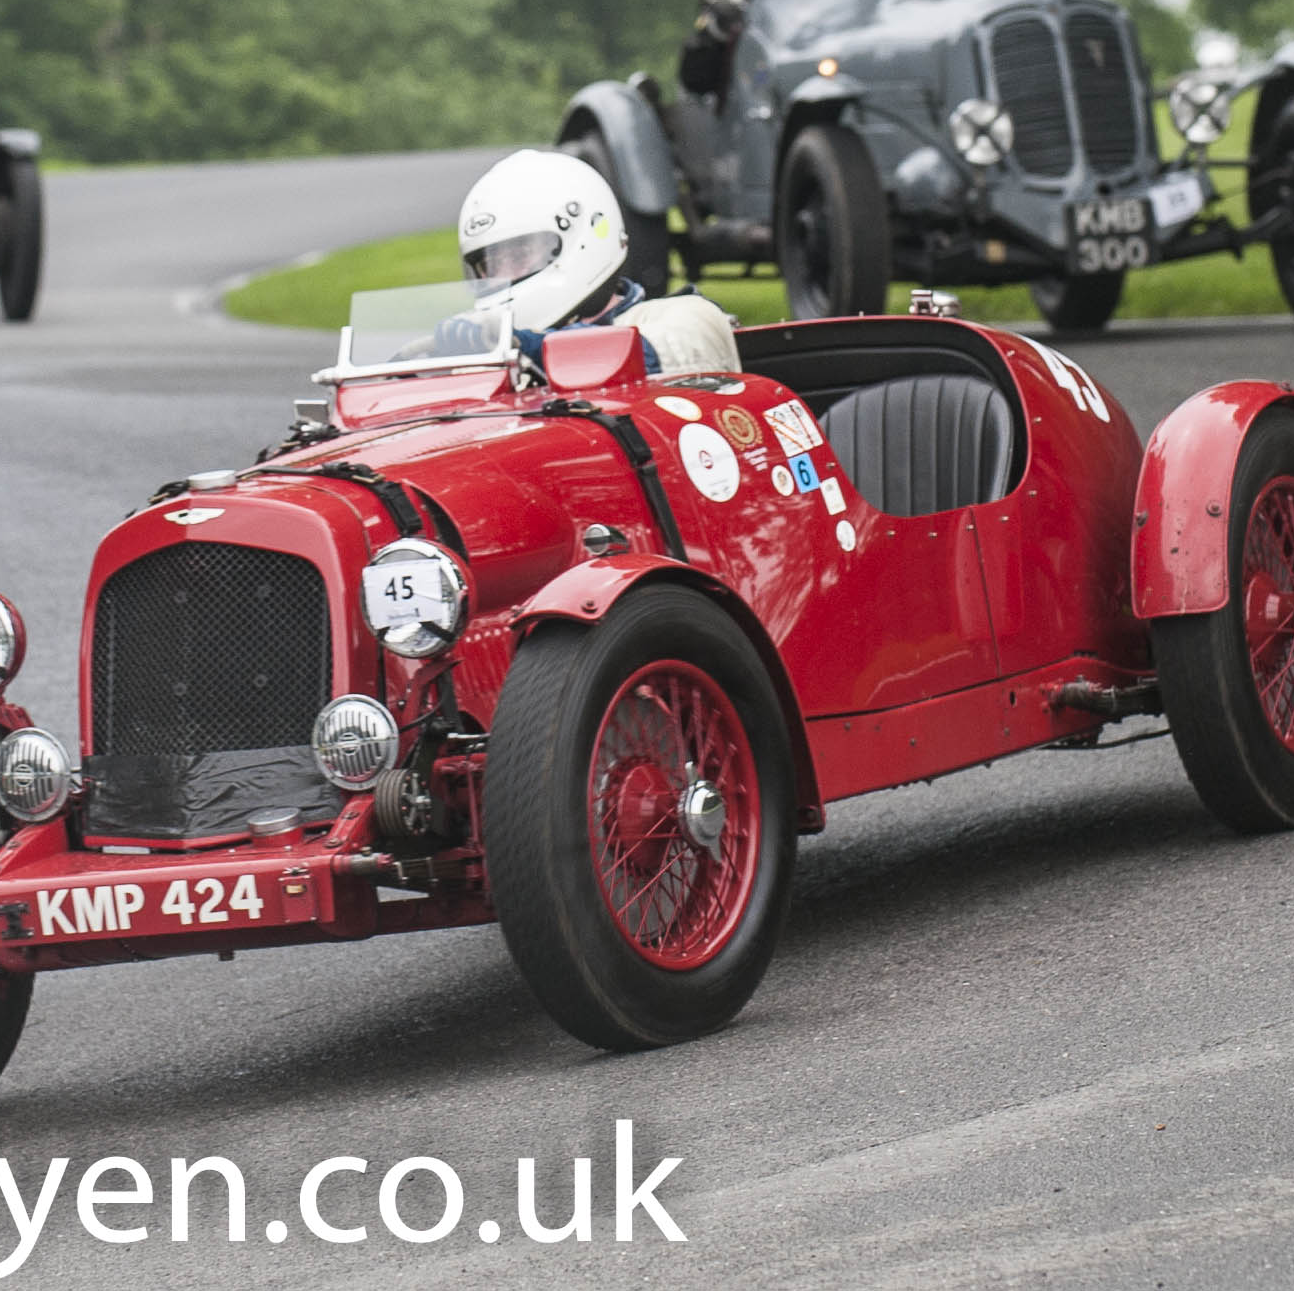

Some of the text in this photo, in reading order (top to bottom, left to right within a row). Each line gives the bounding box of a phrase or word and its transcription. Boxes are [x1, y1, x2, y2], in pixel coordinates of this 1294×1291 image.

[1077, 235, 1149, 272] 300
[797, 460, 811, 487] 6
[384, 575, 414, 602] 45
[36, 874, 264, 936] KMP 424
